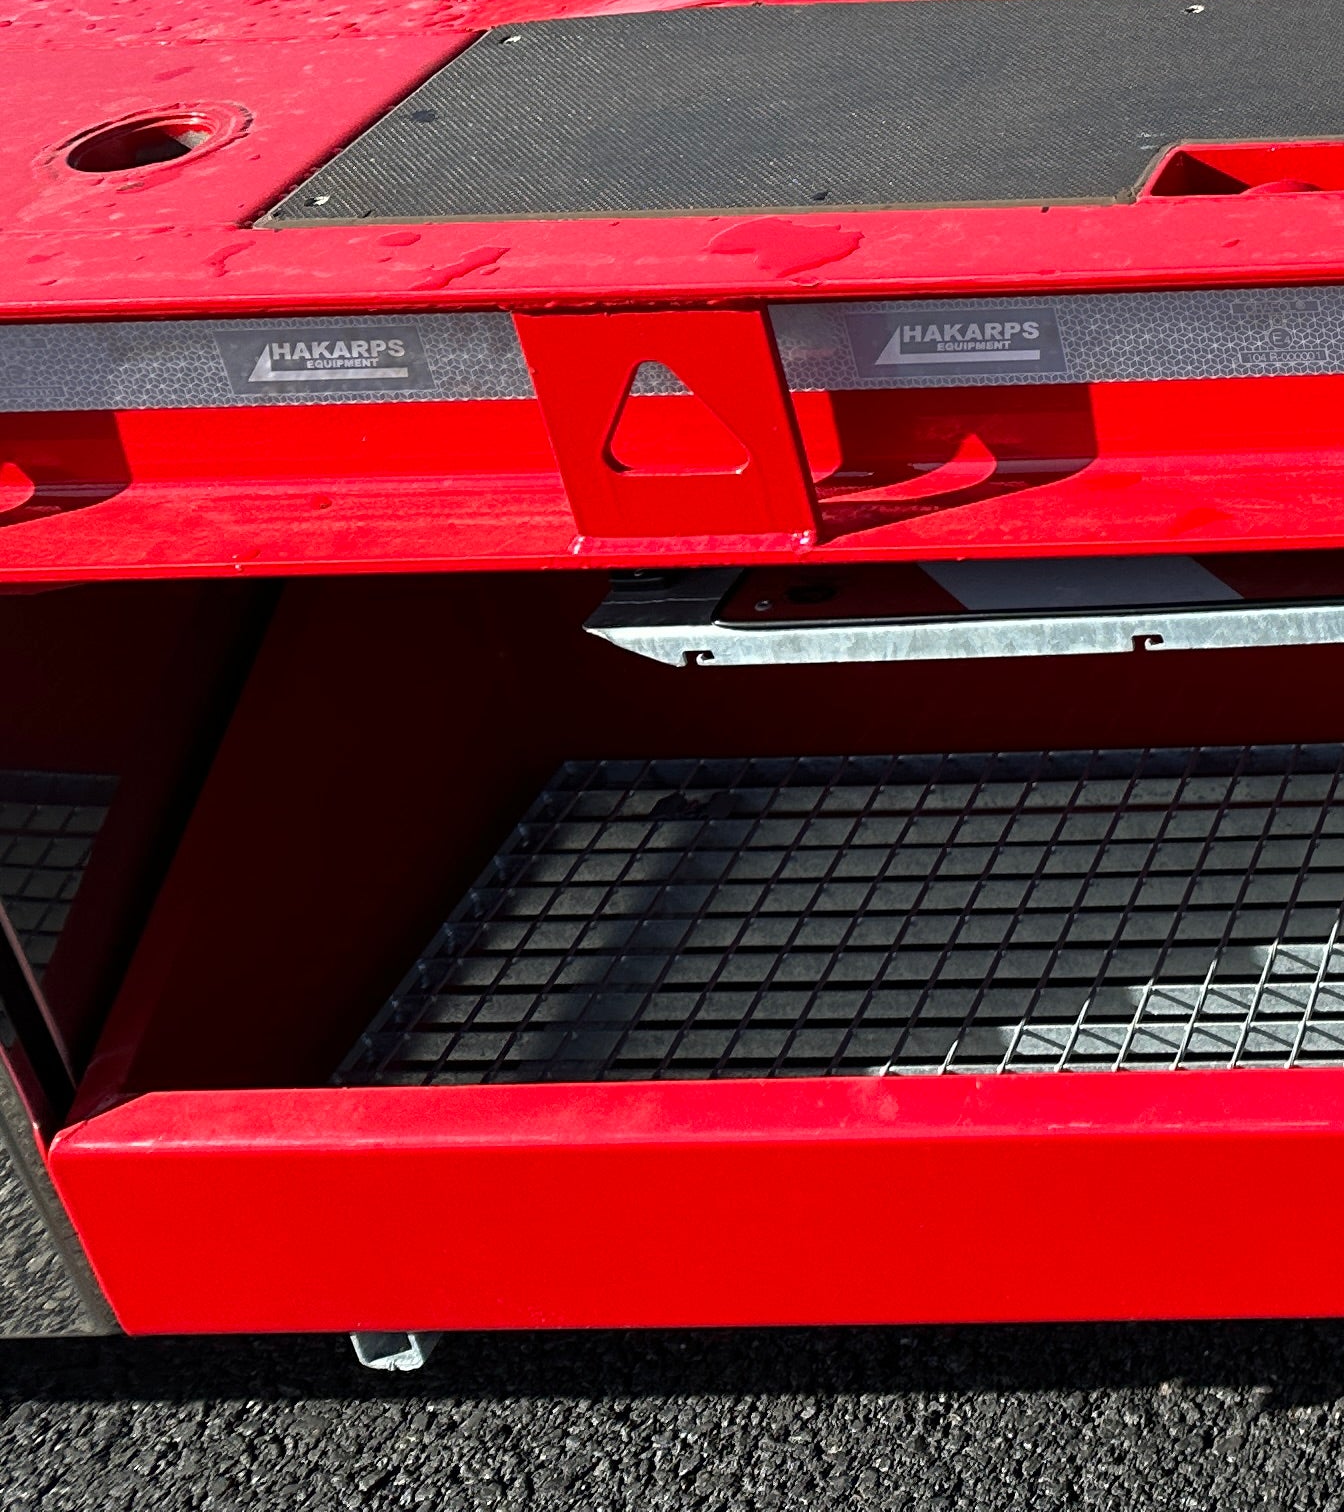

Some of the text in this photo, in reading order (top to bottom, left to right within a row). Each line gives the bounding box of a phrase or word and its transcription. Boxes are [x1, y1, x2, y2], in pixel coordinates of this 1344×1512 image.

[903, 321, 1040, 343] HAKARPS
[270, 338, 406, 360] HAKARPS
[936, 340, 1012, 352] EQUIPMENT
[306, 357, 379, 369] EQUIPMENT
